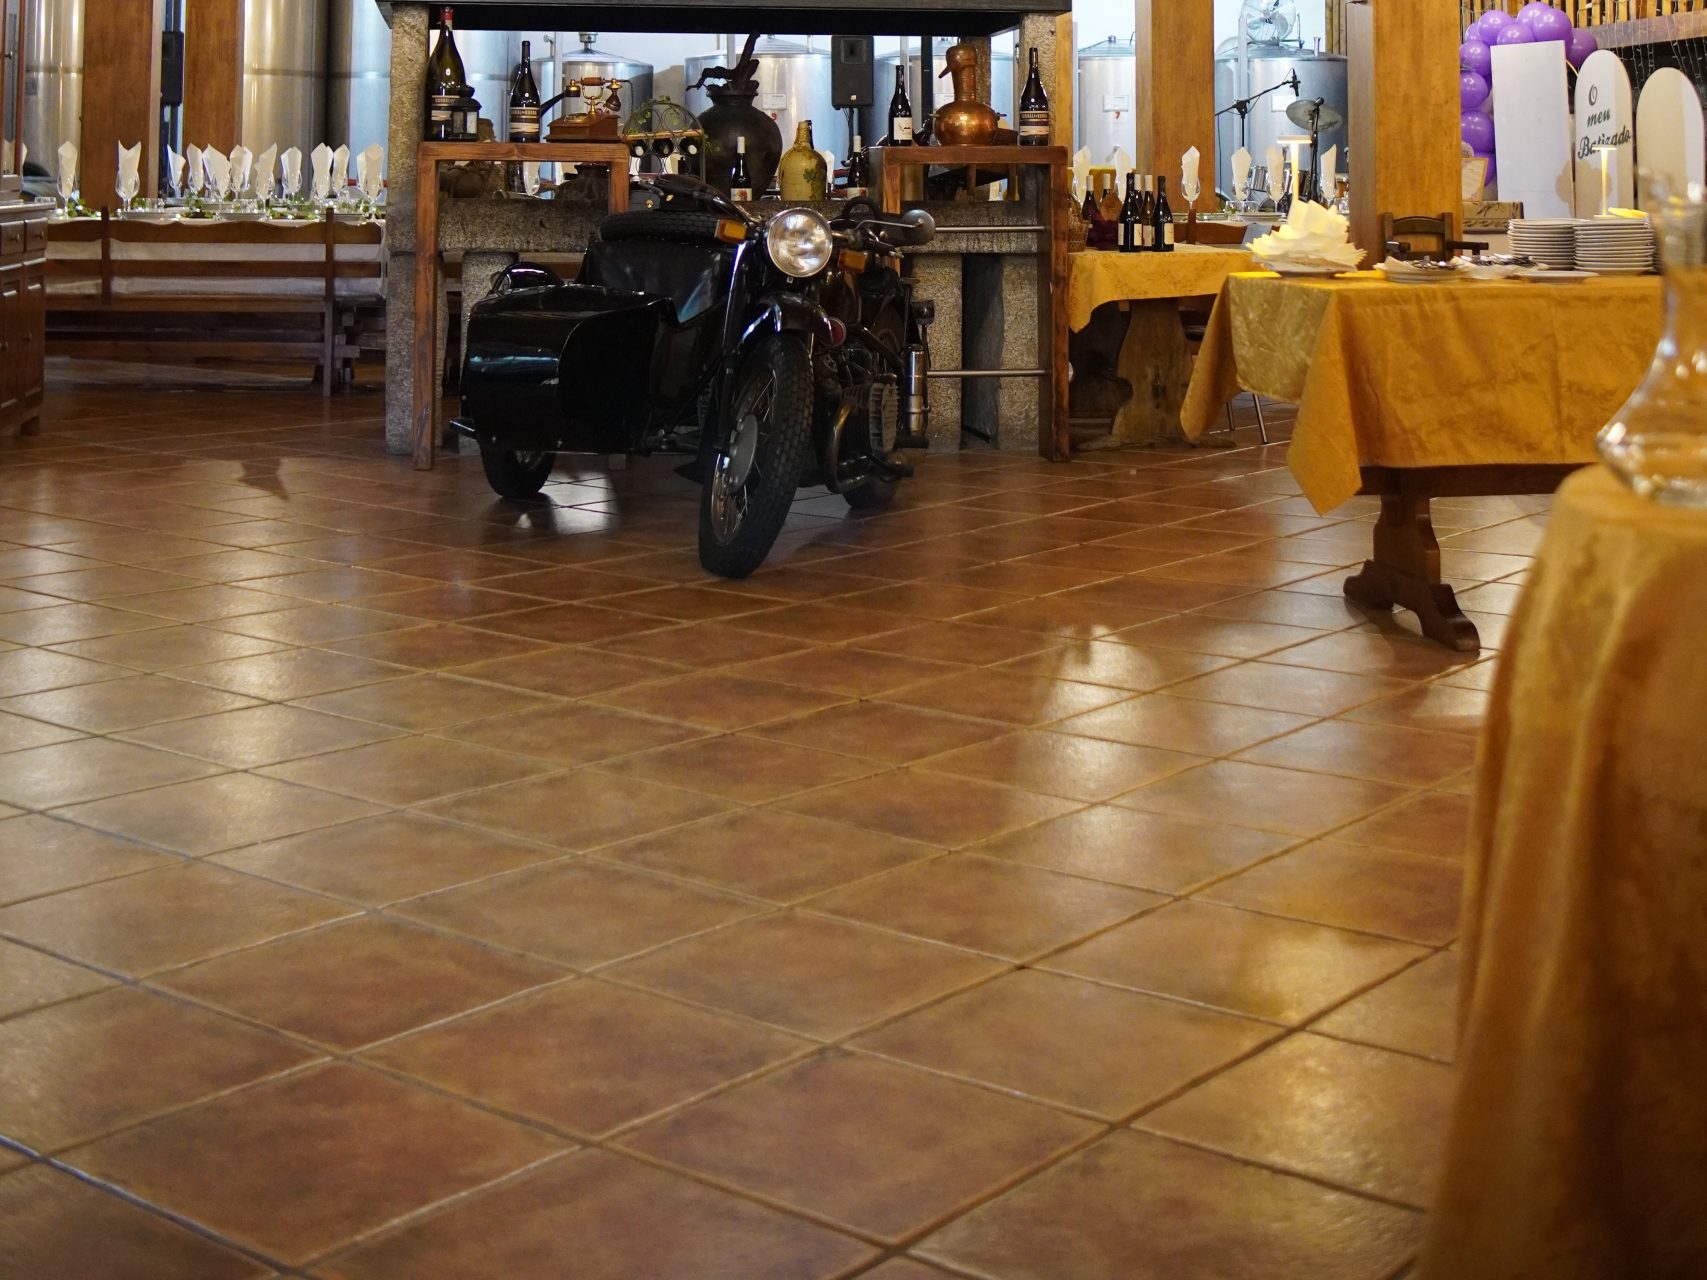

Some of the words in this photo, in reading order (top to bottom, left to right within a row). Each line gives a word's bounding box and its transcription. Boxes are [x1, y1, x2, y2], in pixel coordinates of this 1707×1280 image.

[1588, 84, 1598, 106] O
[771, 112, 777, 121] 9
[1587, 109, 1611, 128] meu
[1577, 124, 1632, 159] Batizado
